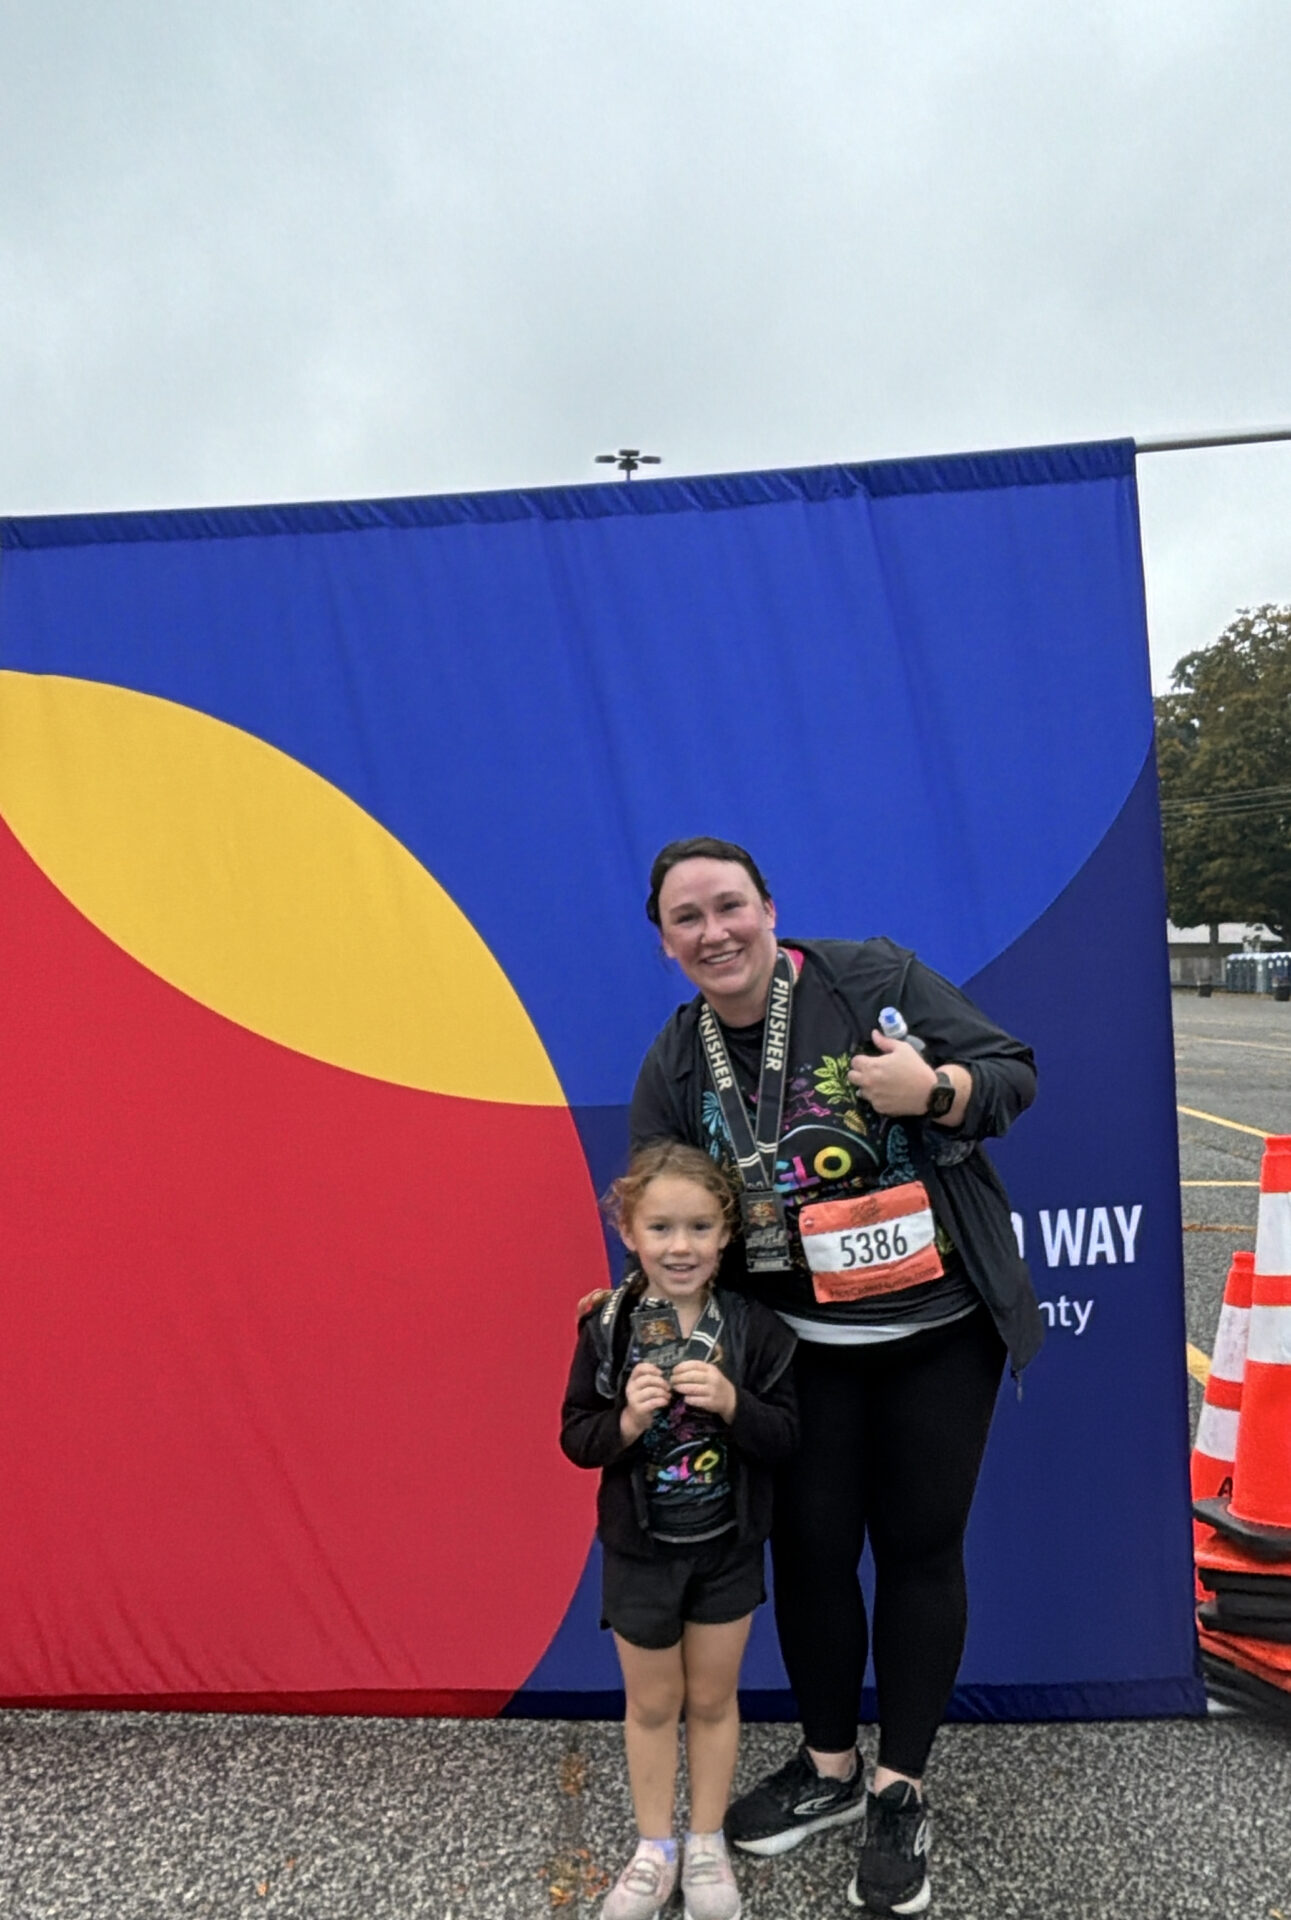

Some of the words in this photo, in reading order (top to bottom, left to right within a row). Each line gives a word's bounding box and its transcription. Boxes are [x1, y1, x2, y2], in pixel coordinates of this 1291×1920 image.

[765, 976, 789, 1072] FINISHER
[840, 1223, 909, 1268] 5386
[1038, 1204, 1143, 1268] WAY
